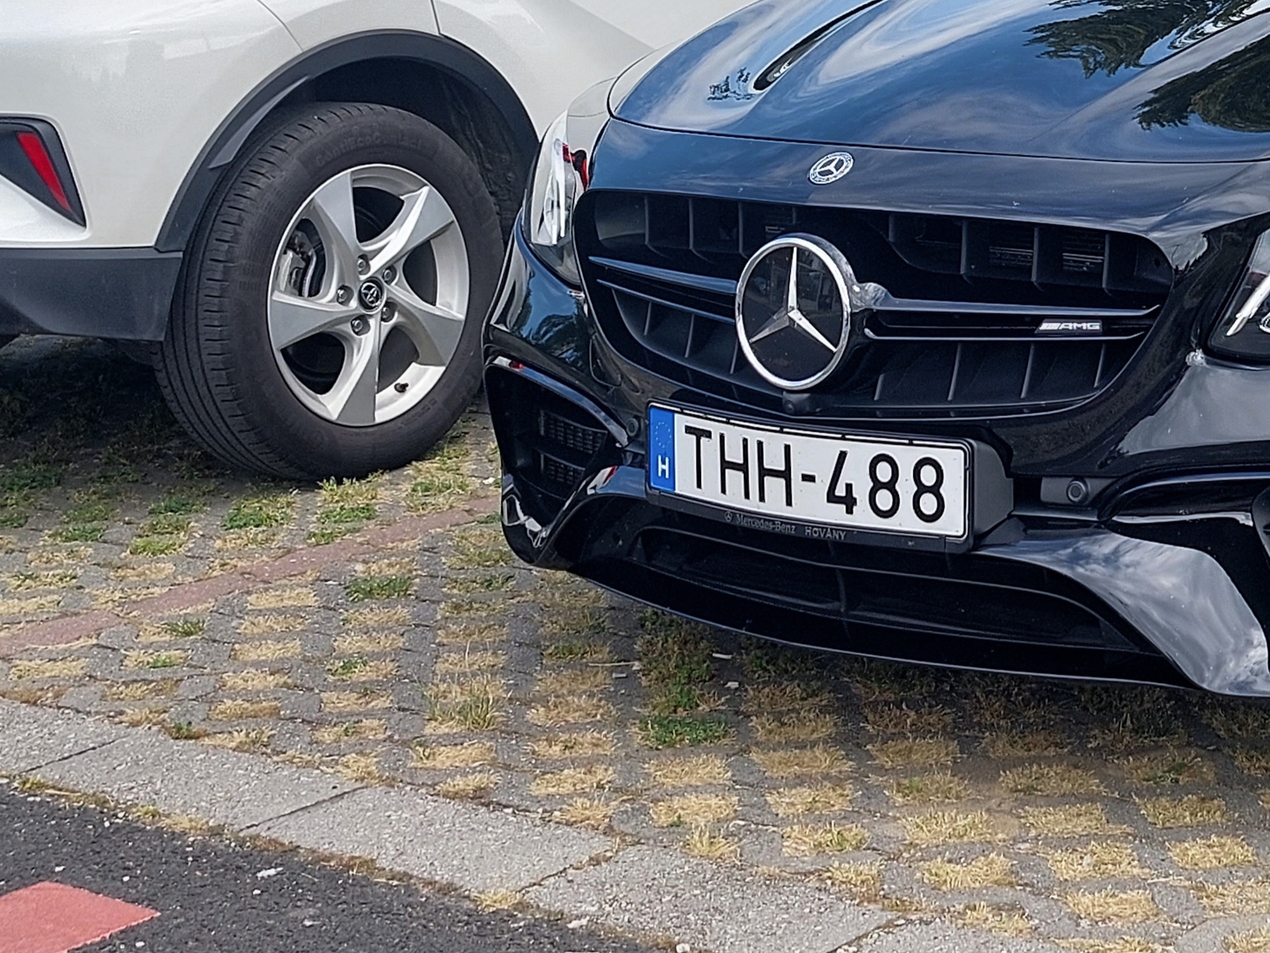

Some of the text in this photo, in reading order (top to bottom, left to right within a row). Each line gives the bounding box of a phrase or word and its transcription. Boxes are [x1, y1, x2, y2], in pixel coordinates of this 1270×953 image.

[1059, 322, 1100, 330] AMG
[657, 455, 669, 479] H
[684, 425, 945, 523] THH-488
[736, 513, 796, 534] Mercedes-Benz
